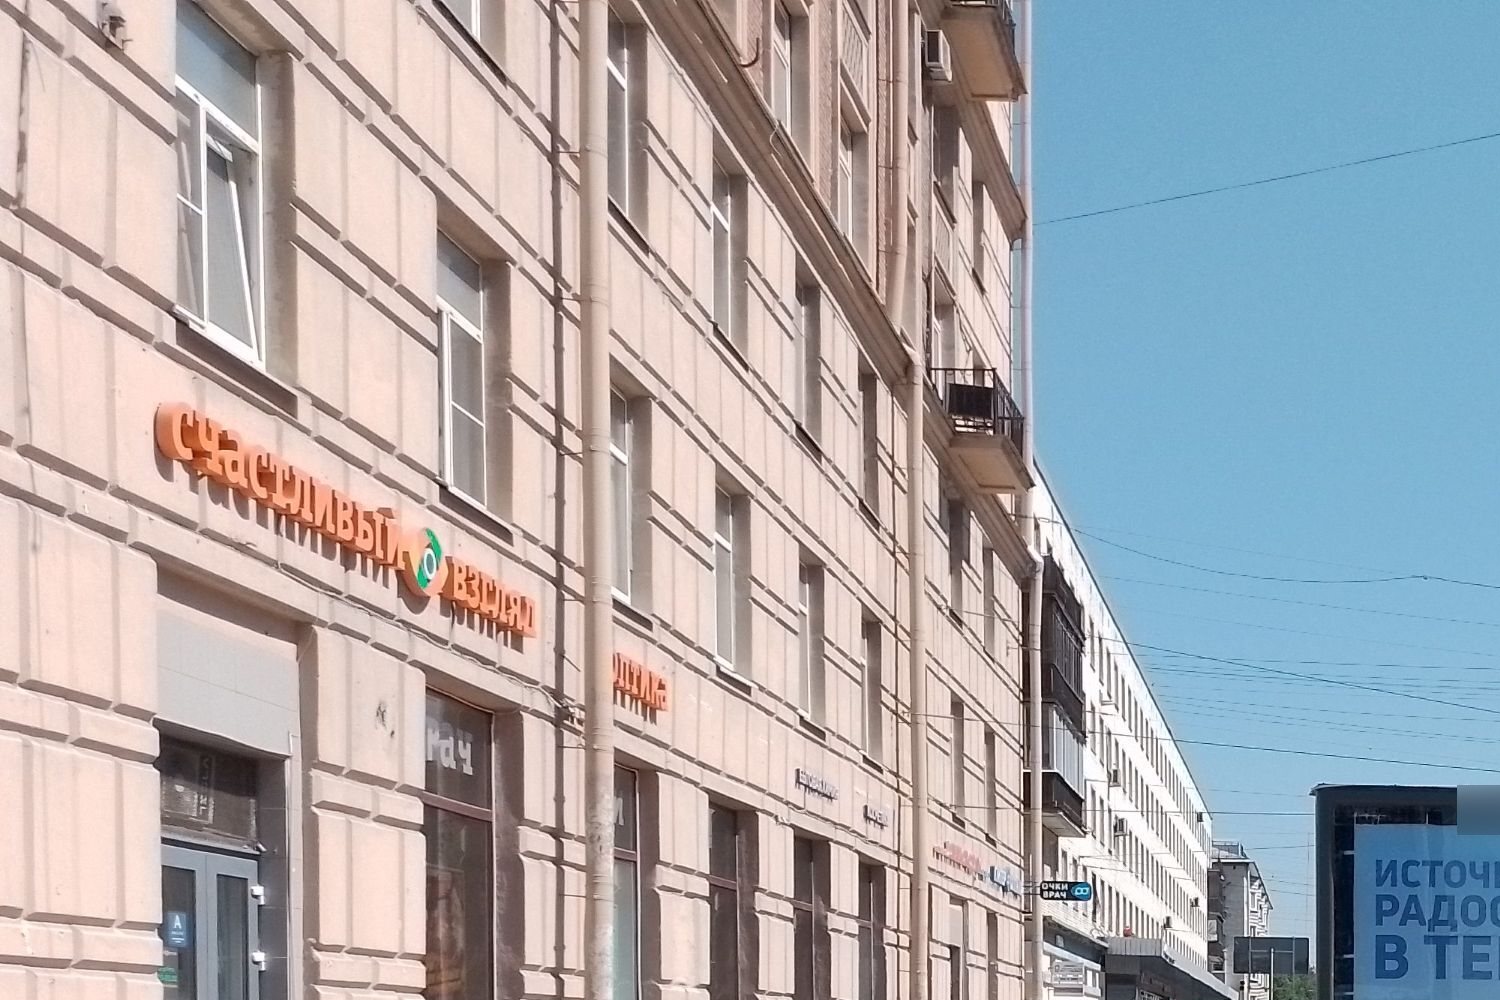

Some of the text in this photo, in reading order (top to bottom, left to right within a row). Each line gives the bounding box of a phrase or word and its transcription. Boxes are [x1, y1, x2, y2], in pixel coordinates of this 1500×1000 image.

[1041, 883, 1069, 891] ОЧКИ
[1042, 891, 1067, 899] ВРАЧ
[1375, 934, 1409, 980] В
